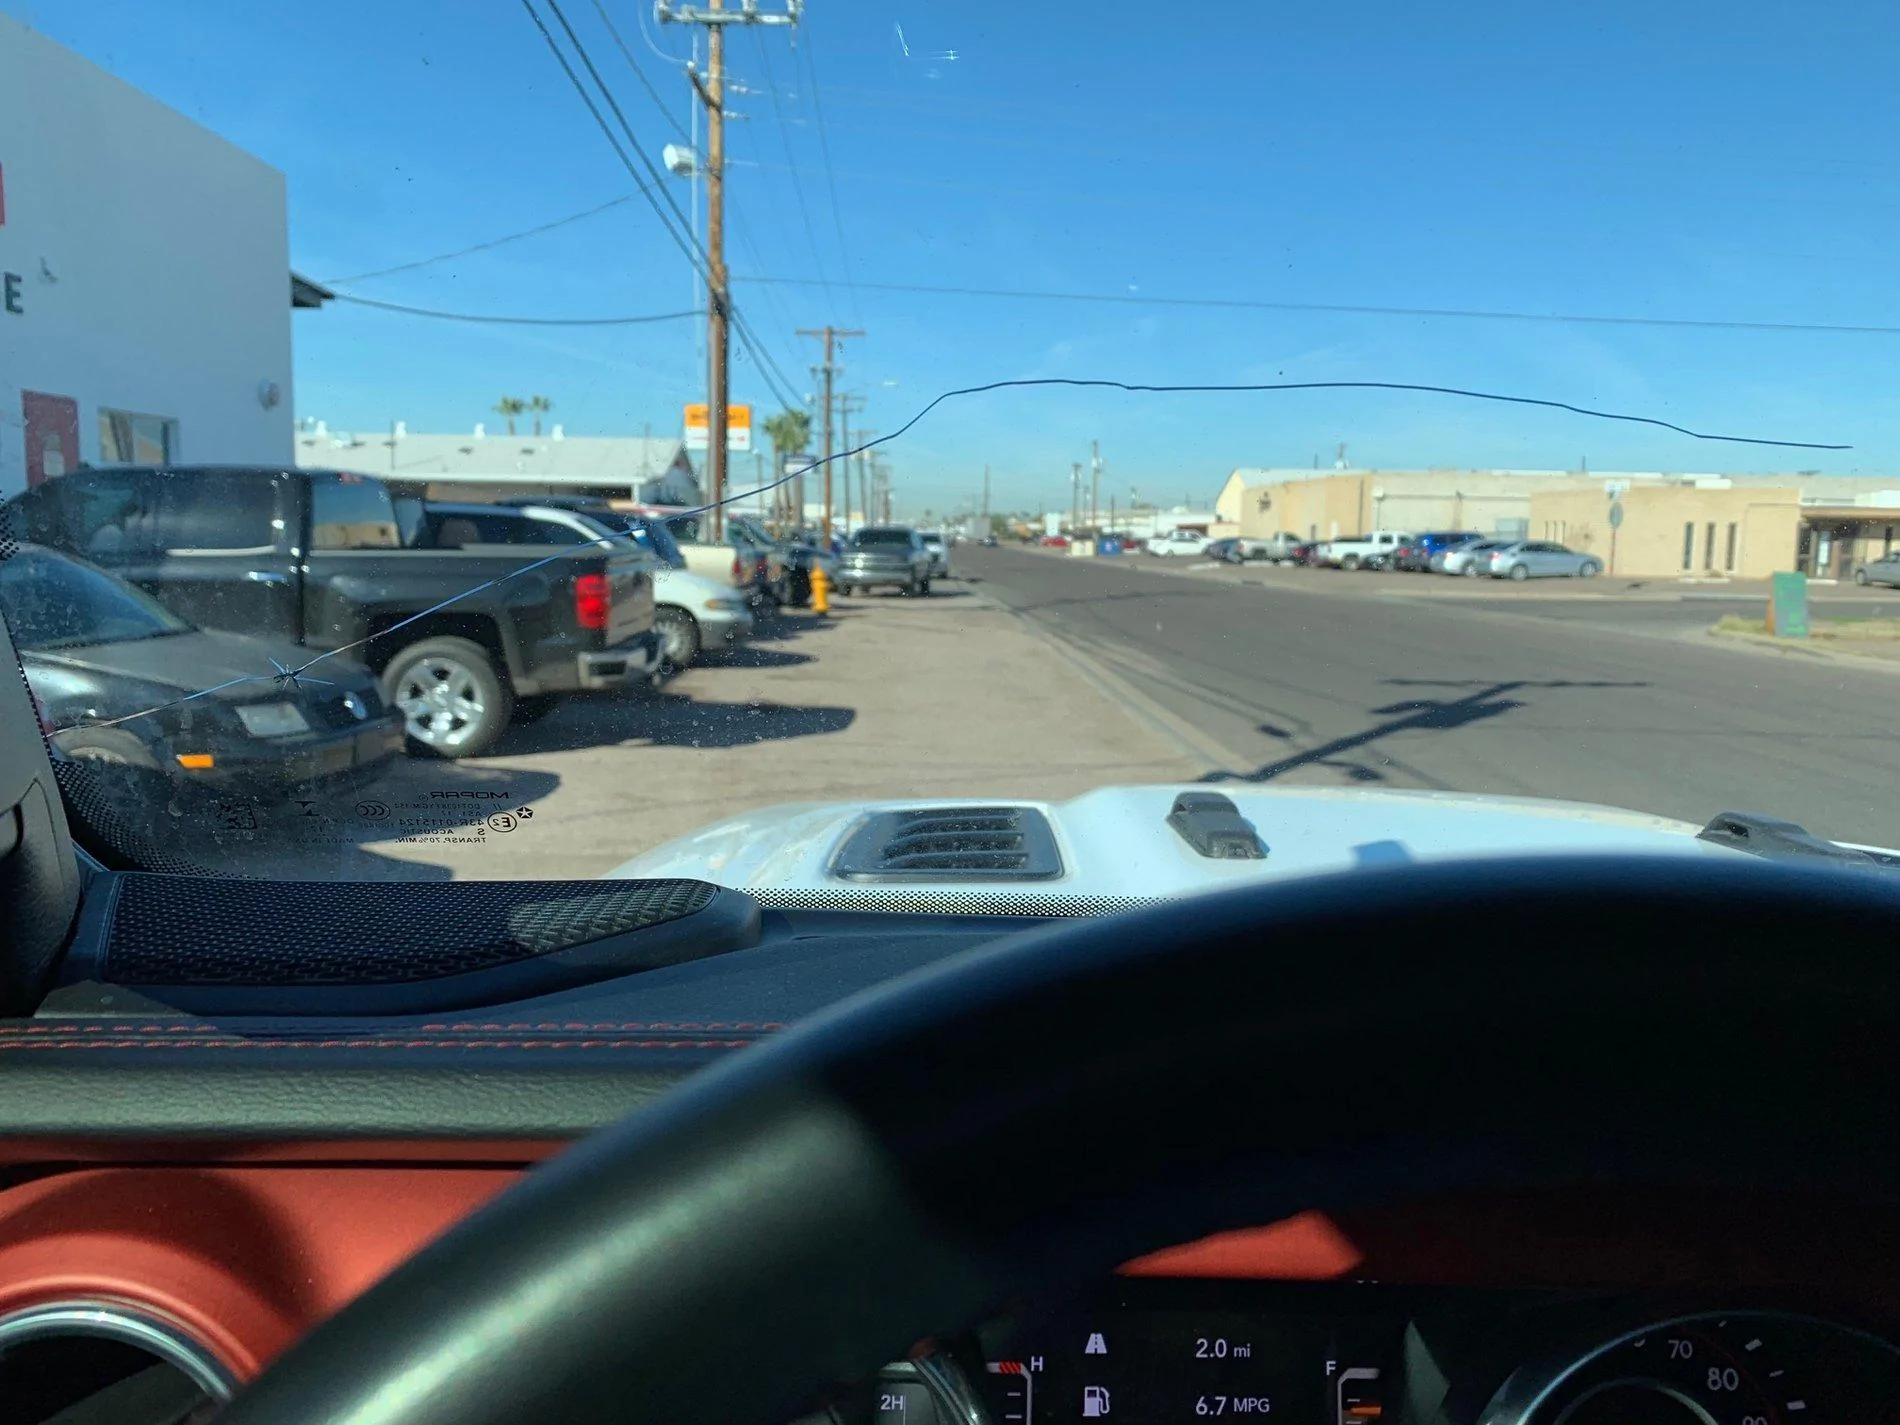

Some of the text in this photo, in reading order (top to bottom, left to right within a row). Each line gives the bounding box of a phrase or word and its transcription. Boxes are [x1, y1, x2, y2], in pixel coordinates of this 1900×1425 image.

[1195, 1338, 1251, 1359] 2.0 mi
[1667, 1340, 1693, 1360] 70
[1030, 1355, 1044, 1373] H
[1325, 1360, 1337, 1376] F
[1706, 1367, 1739, 1392] 80
[880, 1394, 904, 1411] 2H
[1195, 1395, 1271, 1416] 6.7 MPG
